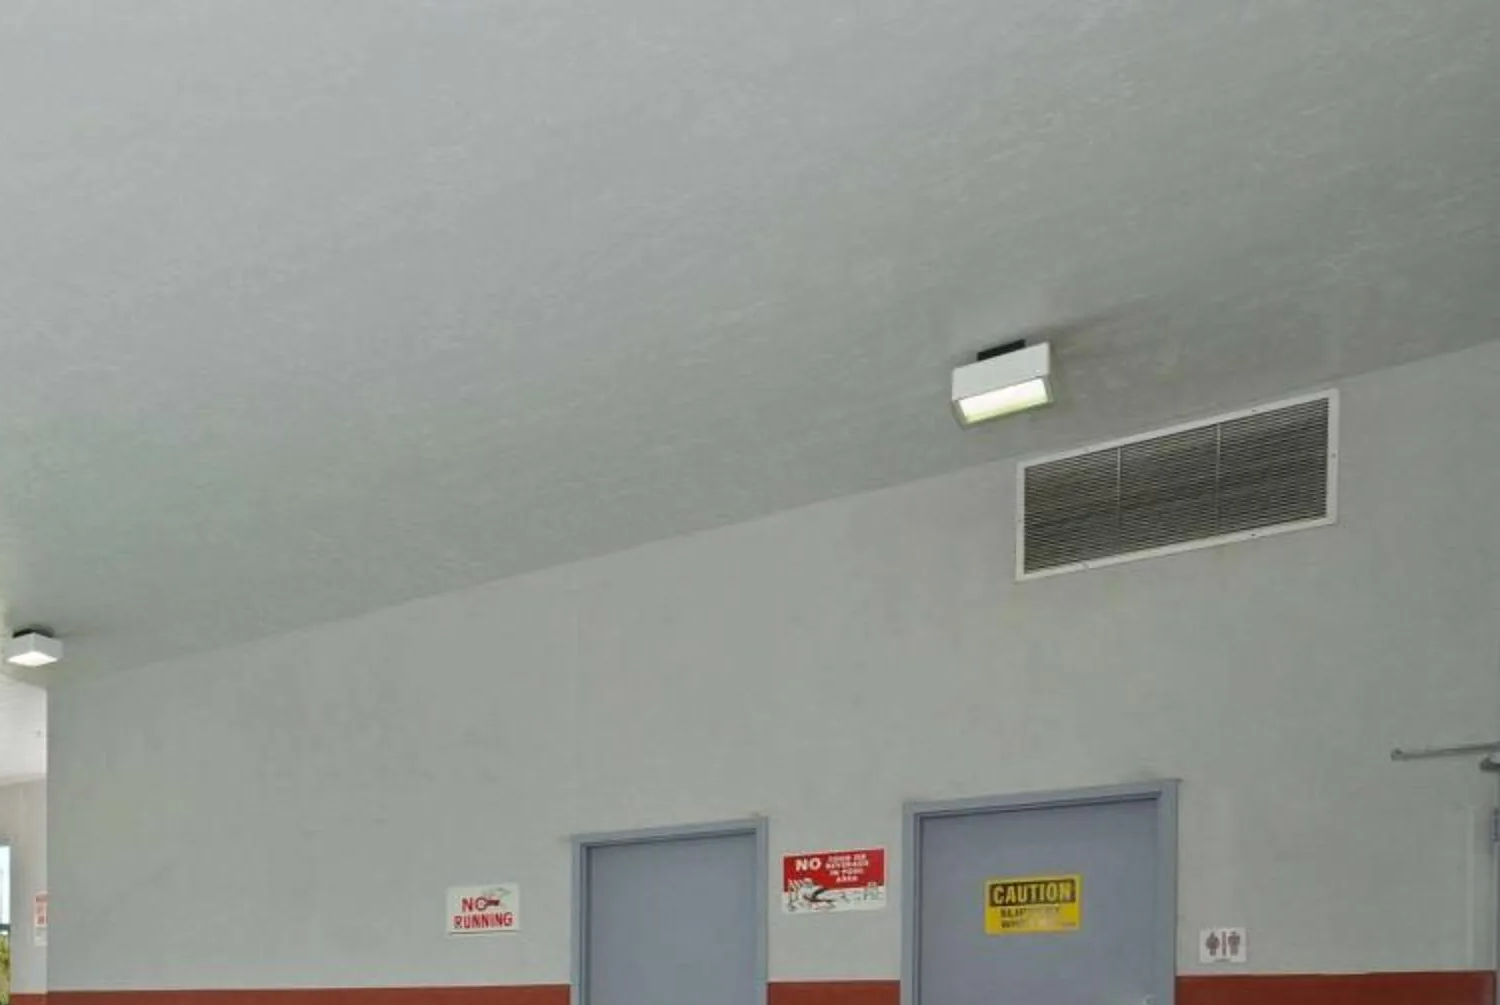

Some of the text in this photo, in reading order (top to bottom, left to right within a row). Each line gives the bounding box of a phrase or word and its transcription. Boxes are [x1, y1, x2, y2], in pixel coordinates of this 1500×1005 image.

[795, 857, 821, 872] NO
[994, 882, 1072, 904] CAUTION
[462, 896, 487, 912] NO
[454, 911, 513, 929] RUNNING
